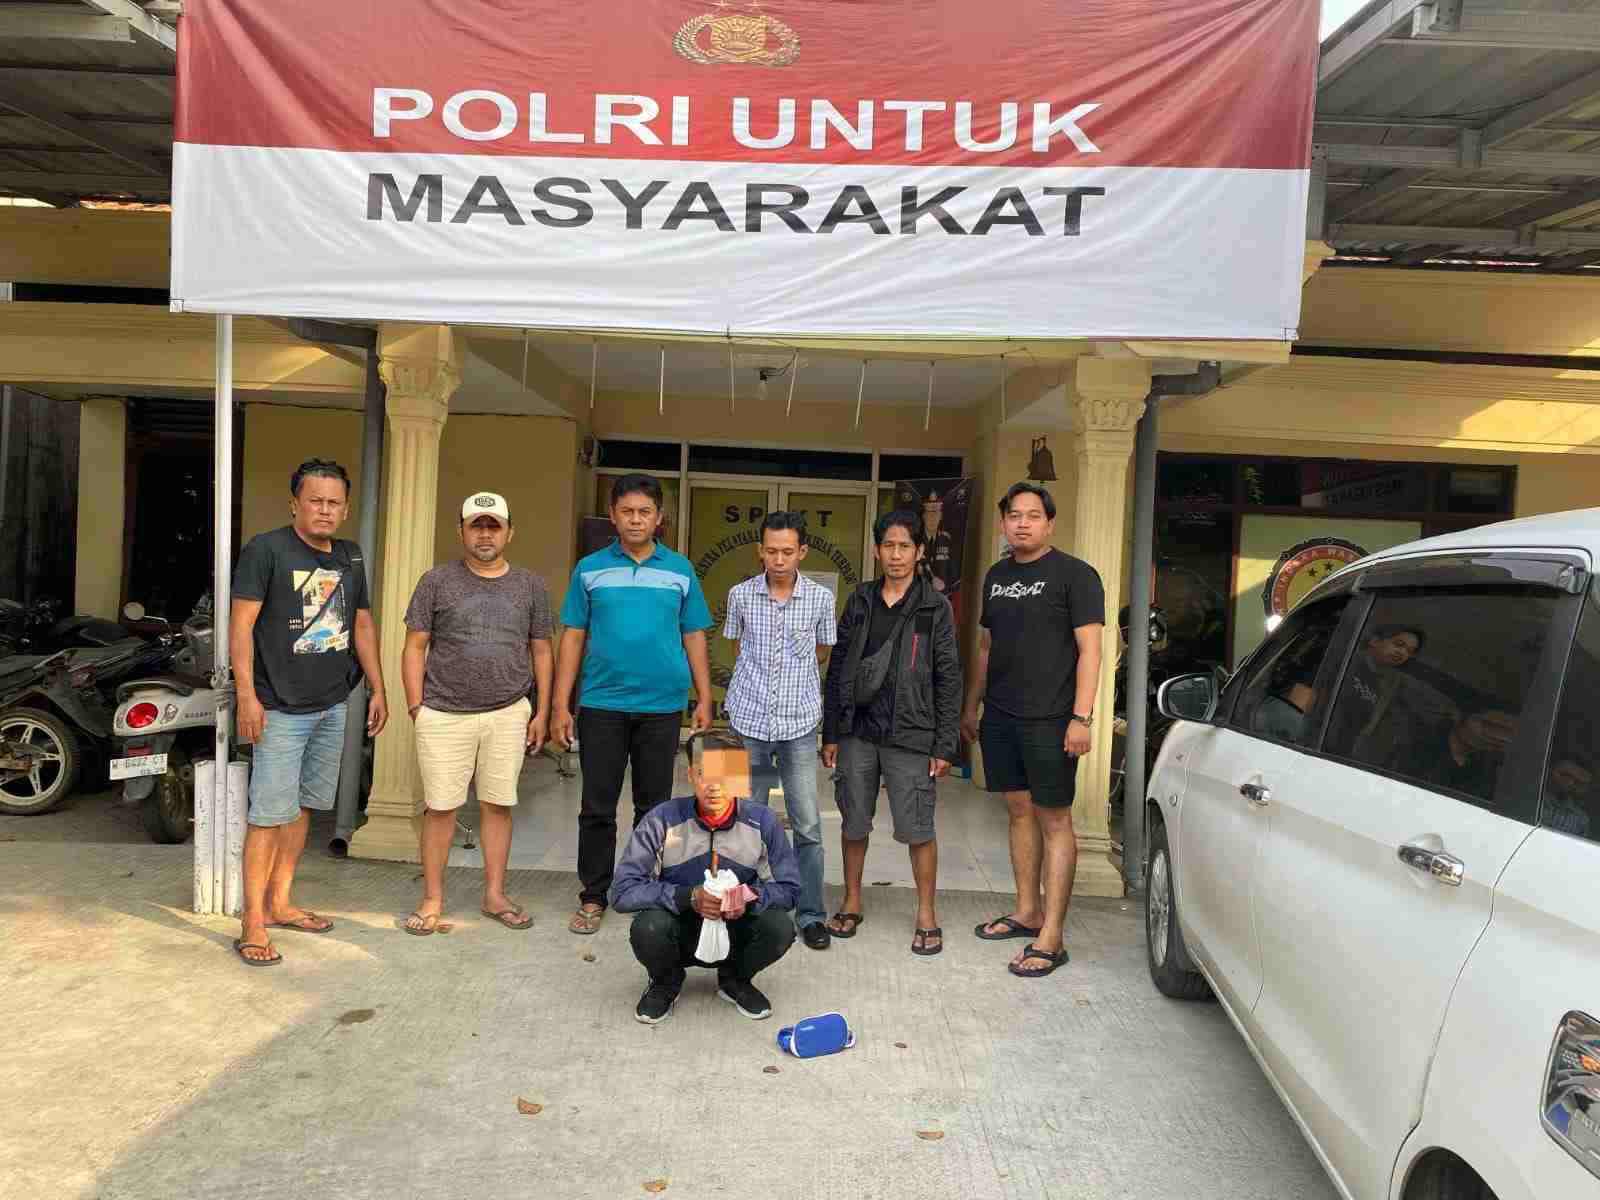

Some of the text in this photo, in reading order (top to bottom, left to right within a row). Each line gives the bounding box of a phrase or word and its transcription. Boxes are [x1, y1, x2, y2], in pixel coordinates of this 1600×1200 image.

[373, 87, 1103, 153] POLRI UNTUK
[366, 173, 1106, 236] MASYARAKAT
